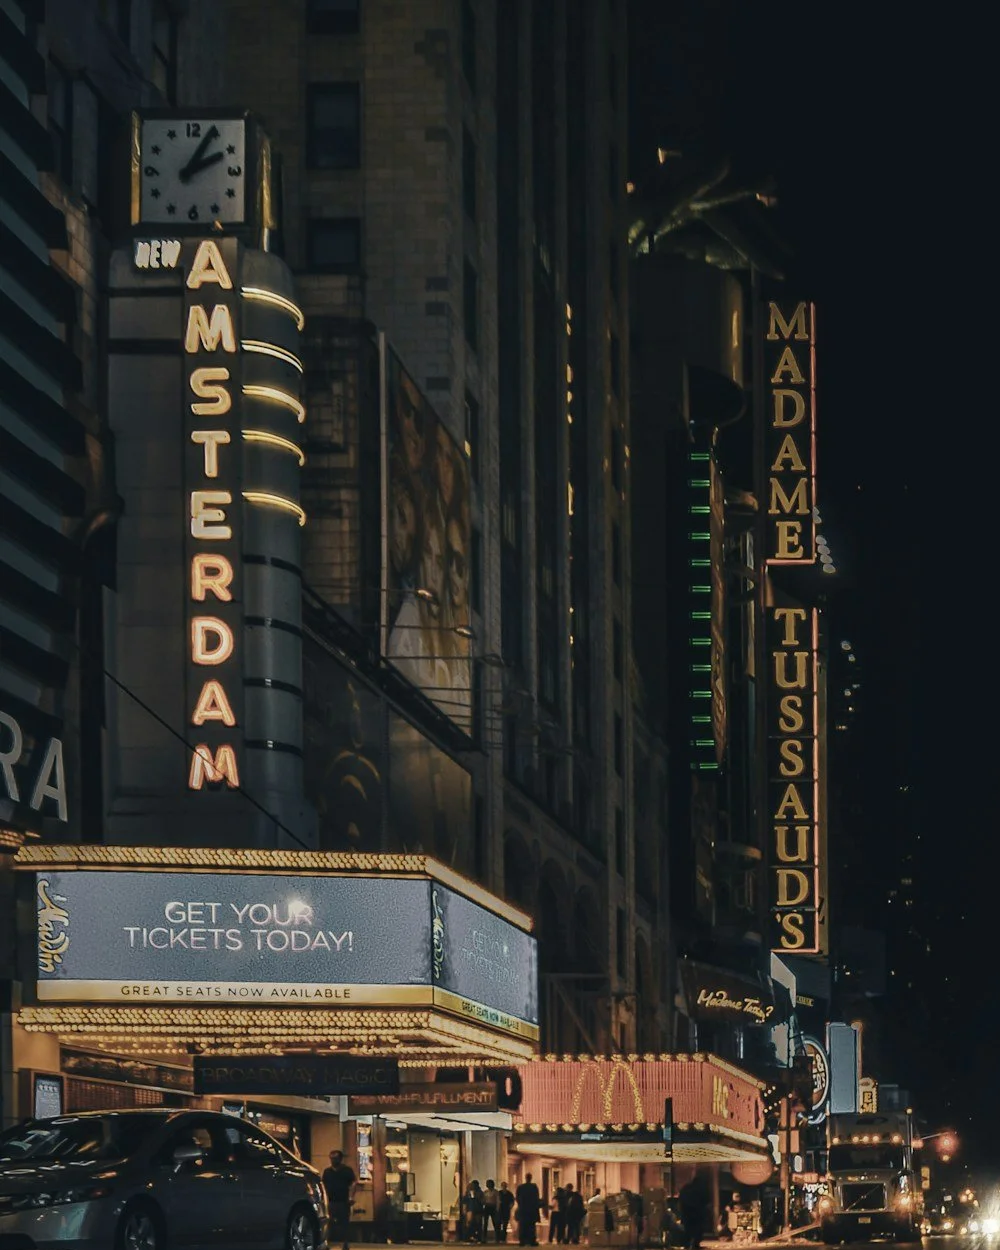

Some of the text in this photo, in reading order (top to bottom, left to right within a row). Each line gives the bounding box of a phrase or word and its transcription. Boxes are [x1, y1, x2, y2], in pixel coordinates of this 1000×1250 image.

[186, 123, 201, 138] 12
[188, 205, 199, 221] 6
[766, 301, 809, 560] MADAME
[135, 239, 240, 791] NEW AMSTERDAM
[164, 902, 313, 926] GET YOUR
[123, 926, 353, 952] TICKETS TODAY!
[121, 986, 351, 999] GREAT SEATS NOW AVAILABLE
